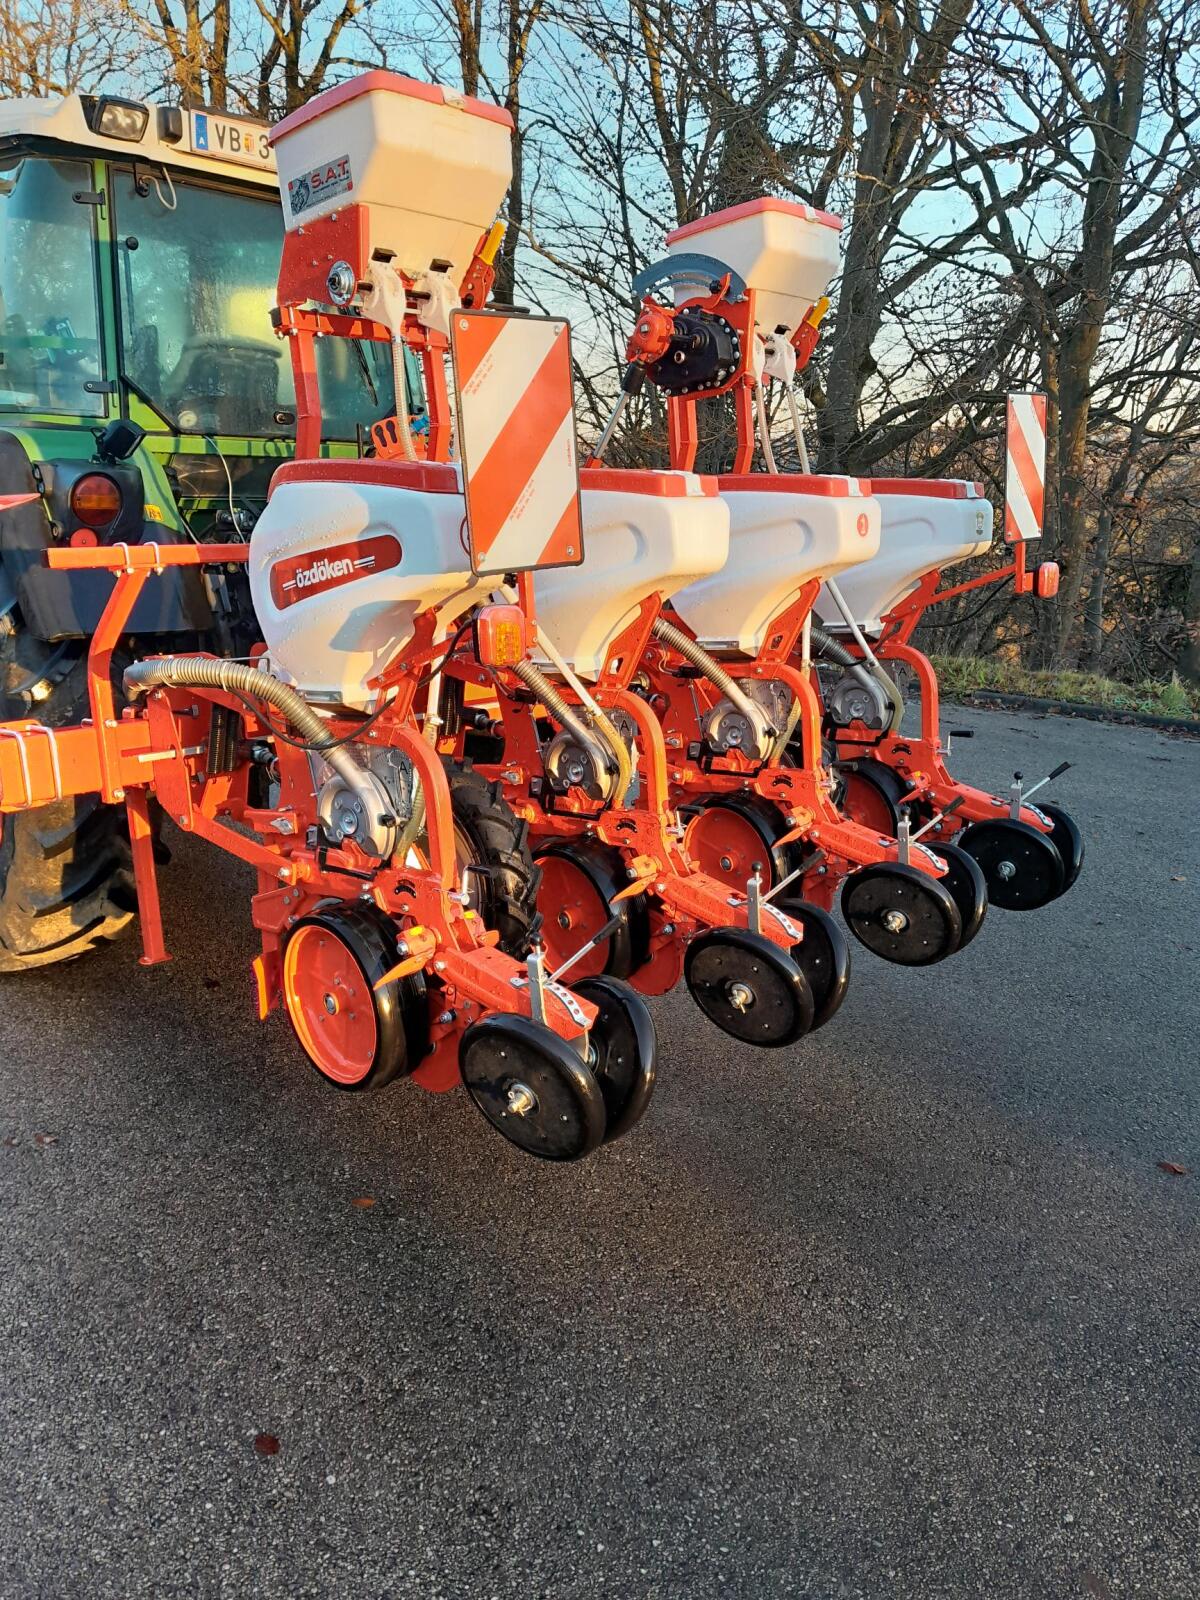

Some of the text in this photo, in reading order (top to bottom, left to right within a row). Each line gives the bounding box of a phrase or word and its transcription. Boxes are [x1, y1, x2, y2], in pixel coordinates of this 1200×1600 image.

[199, 136, 206, 145] A
[215, 123, 241, 152] VB
[311, 160, 350, 189] S.A.T.
[296, 558, 354, 588] özdöken
[898, 667, 907, 676] A
[777, 690, 787, 700] A
[620, 719, 630, 731] A
[400, 760, 409, 775] A
